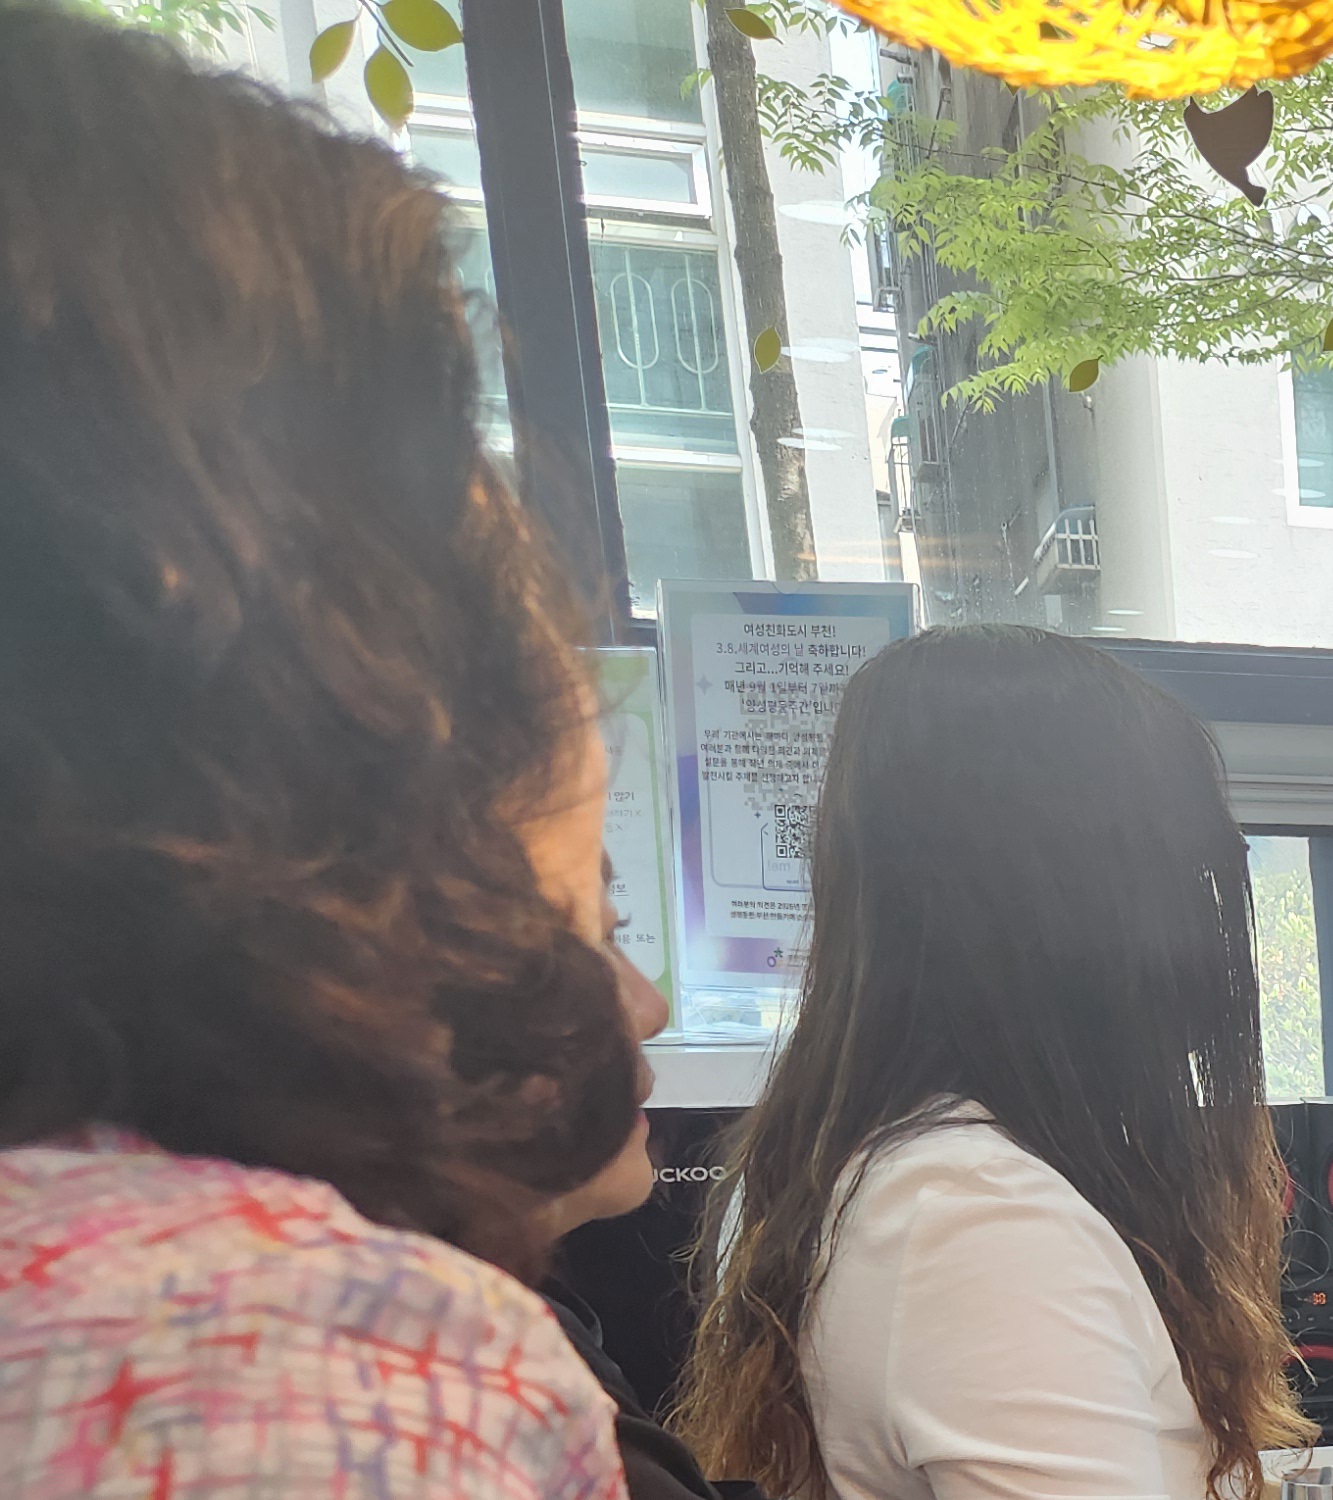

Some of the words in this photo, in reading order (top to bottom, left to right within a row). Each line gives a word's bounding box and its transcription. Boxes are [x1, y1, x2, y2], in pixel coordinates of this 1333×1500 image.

[743, 623, 807, 638] 여성친화도시
[811, 624, 837, 638] 부천!
[716, 642, 791, 657] 3.8.세계여성의
[807, 644, 867, 658] 축하합니다!
[735, 661, 810, 676] 그리고...기억해
[812, 663, 850, 676] 주세요!
[724, 679, 746, 694] 매년
[749, 680, 766, 694] 9월
[771, 681, 808, 695] 1일부터
